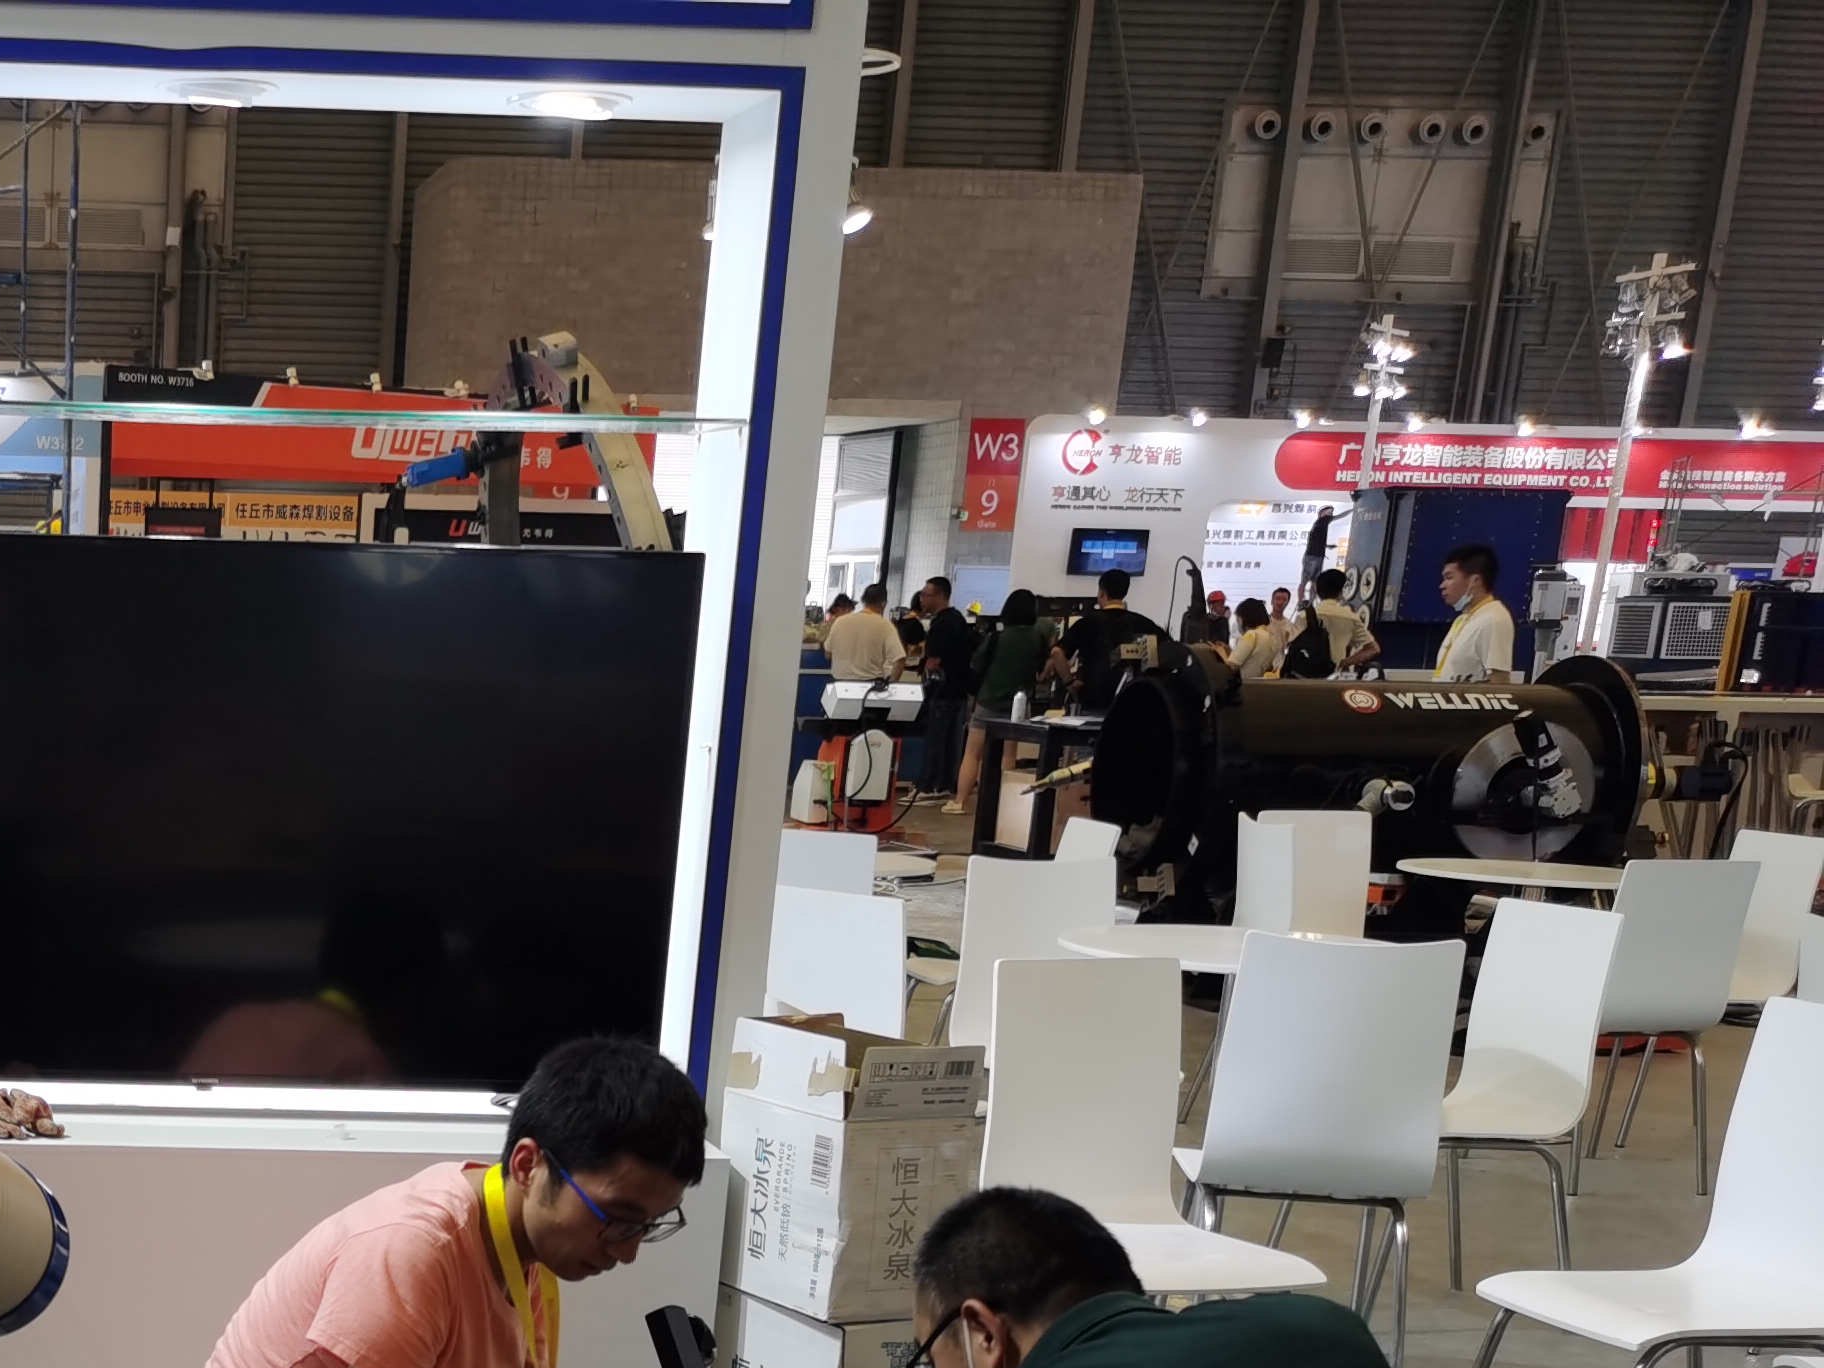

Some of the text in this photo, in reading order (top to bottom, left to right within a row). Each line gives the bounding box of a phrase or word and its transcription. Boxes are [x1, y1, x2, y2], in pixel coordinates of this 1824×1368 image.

[118, 372, 194, 387] BOOTH NO. W3716
[974, 432, 1019, 461] W3
[1072, 449, 1103, 457] HERON
[1108, 443, 1182, 466] 亨龙智能
[1336, 470, 1614, 488] HEON INTELLIGENT EQUIPMENT CO.,LT
[981, 489, 999, 516] 9
[1051, 485, 1185, 504] 亨通其心 龙行天下
[977, 519, 996, 528] Gate
[773, 1141, 787, 1212] EVERGRANDE
[782, 1143, 794, 1194] SPRING
[747, 1137, 777, 1260] 恒大冰泉
[882, 1157, 921, 1280] 恒大冰泉
